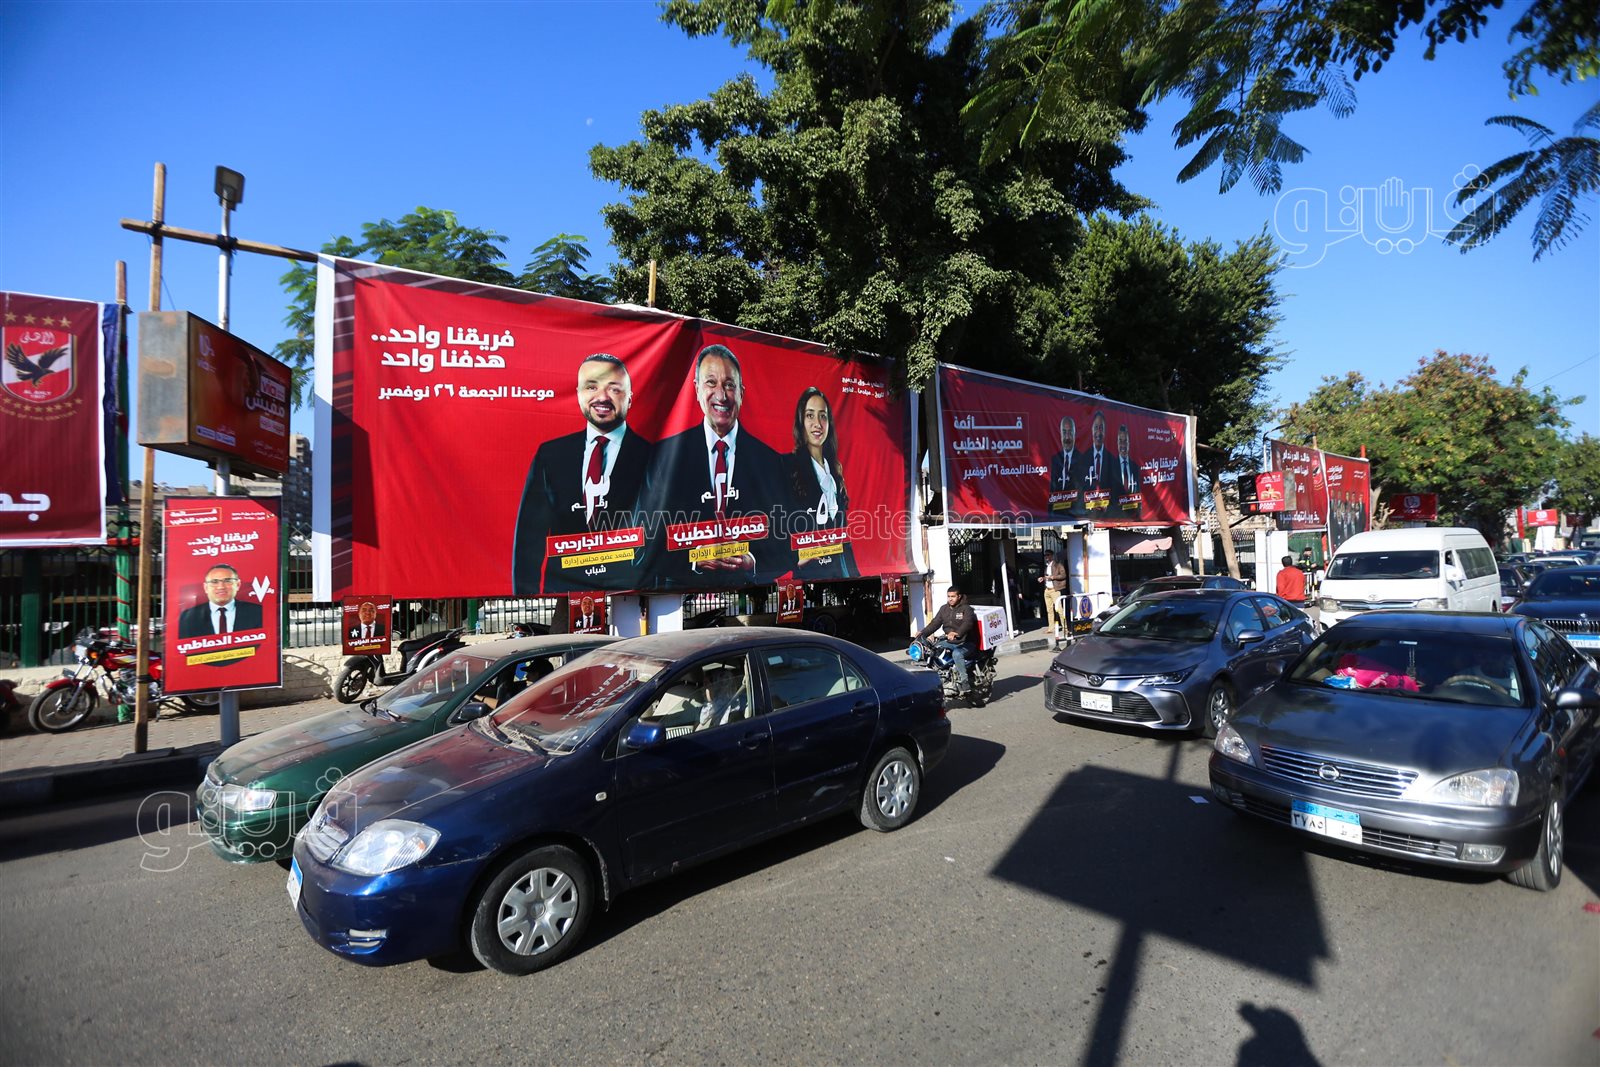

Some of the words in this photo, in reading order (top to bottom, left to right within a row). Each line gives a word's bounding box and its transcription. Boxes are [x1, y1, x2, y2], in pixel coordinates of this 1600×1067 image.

[447, 326, 515, 350] فريقنا
[381, 349, 434, 372] واحد
[440, 349, 506, 368] هدفنا
[378, 385, 430, 401] نوفمبر
[433, 384, 454, 397] ٢٦
[458, 385, 508, 400] الجمعة
[511, 386, 554, 401] موعدنا
[953, 414, 1023, 430] قائمة
[953, 436, 989, 455] الخطيب
[991, 440, 1023, 454] محمود
[963, 466, 987, 480] نوفمبر
[1000, 464, 1025, 477] الجمعة
[1025, 464, 1048, 476] موعدنا
[224, 531, 259, 543] فريقنا
[673, 524, 722, 546] الخطيب
[725, 523, 765, 539] محمود
[828, 532, 847, 543] مي
[554, 536, 603, 553] الجارحي
[606, 533, 639, 545] محمد
[796, 534, 828, 545] عاطف
[192, 546, 218, 556] واحد
[221, 543, 254, 553] هدفنا
[713, 548, 732, 557] مجلس
[731, 545, 748, 553] رئيس
[585, 564, 606, 576] شباب
[177, 636, 232, 653] الدماطي
[234, 633, 266, 643] محمد
